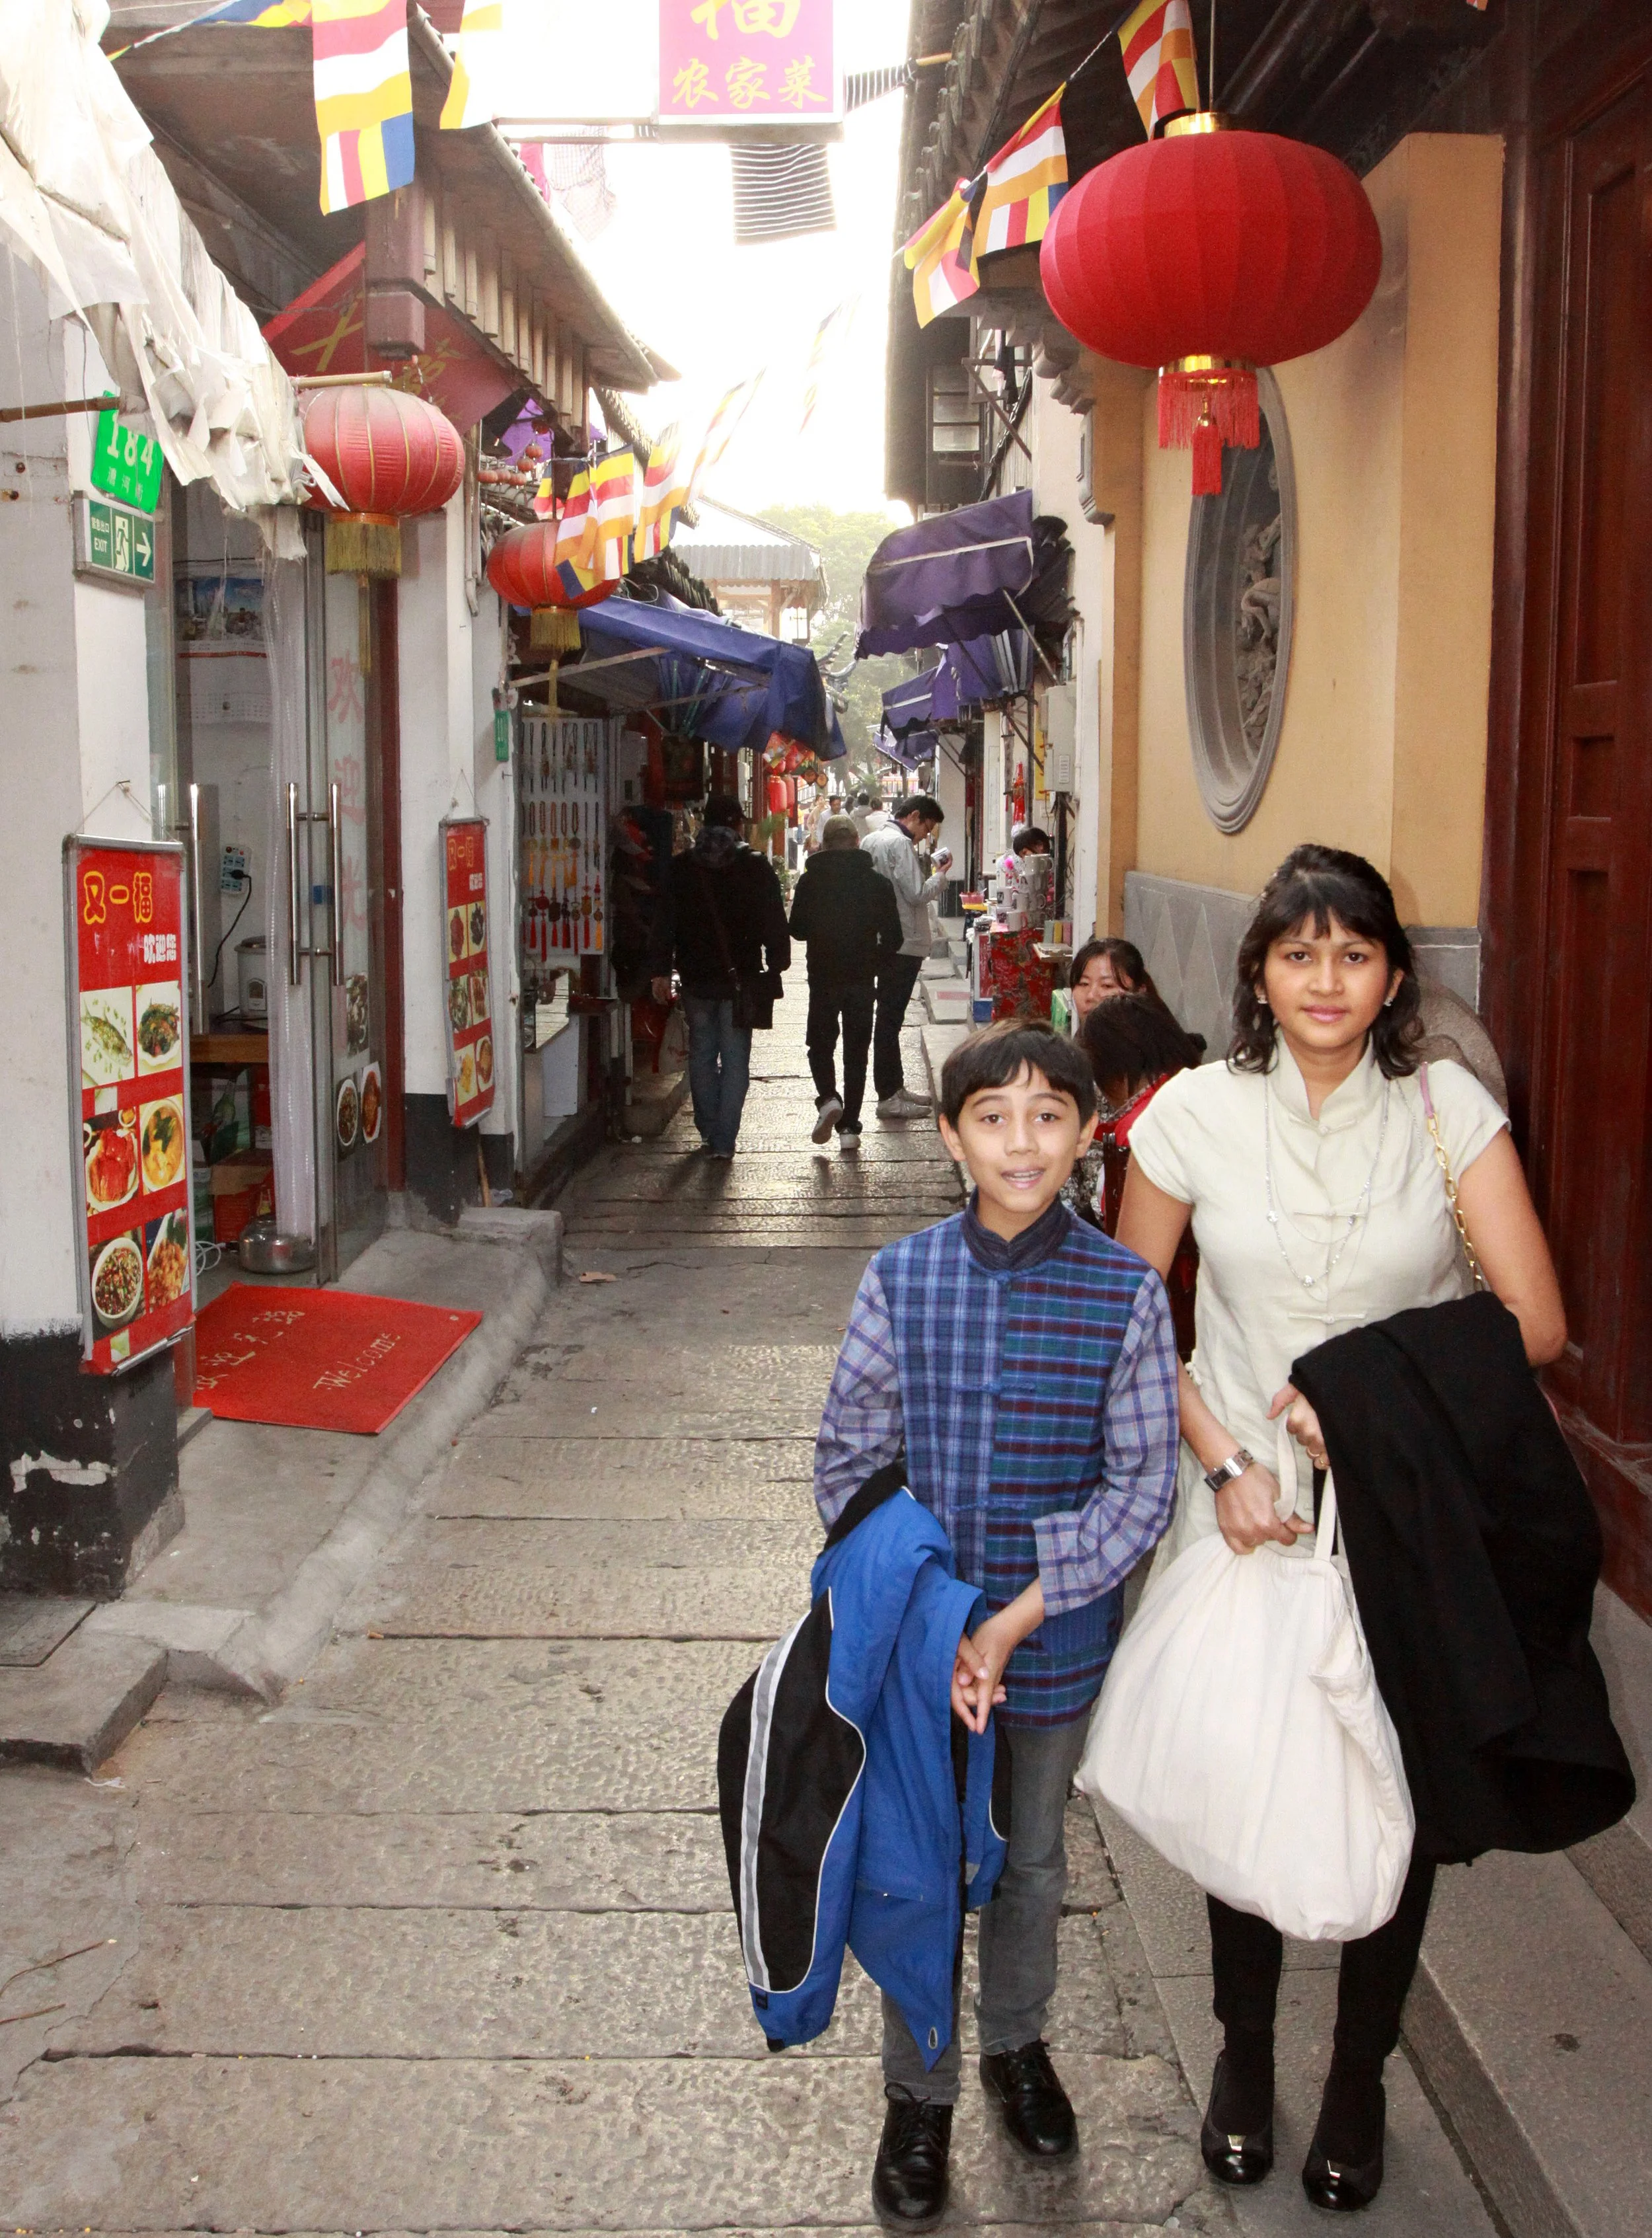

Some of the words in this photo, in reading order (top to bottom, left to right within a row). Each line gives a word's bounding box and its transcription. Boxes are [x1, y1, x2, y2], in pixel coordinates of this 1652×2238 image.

[671, 55, 828, 109] 农家菜
[107, 410, 153, 476] 184
[94, 537, 107, 553] EXIT
[83, 870, 153, 925] 又一福
[313, 1332, 401, 1390] Welcome
